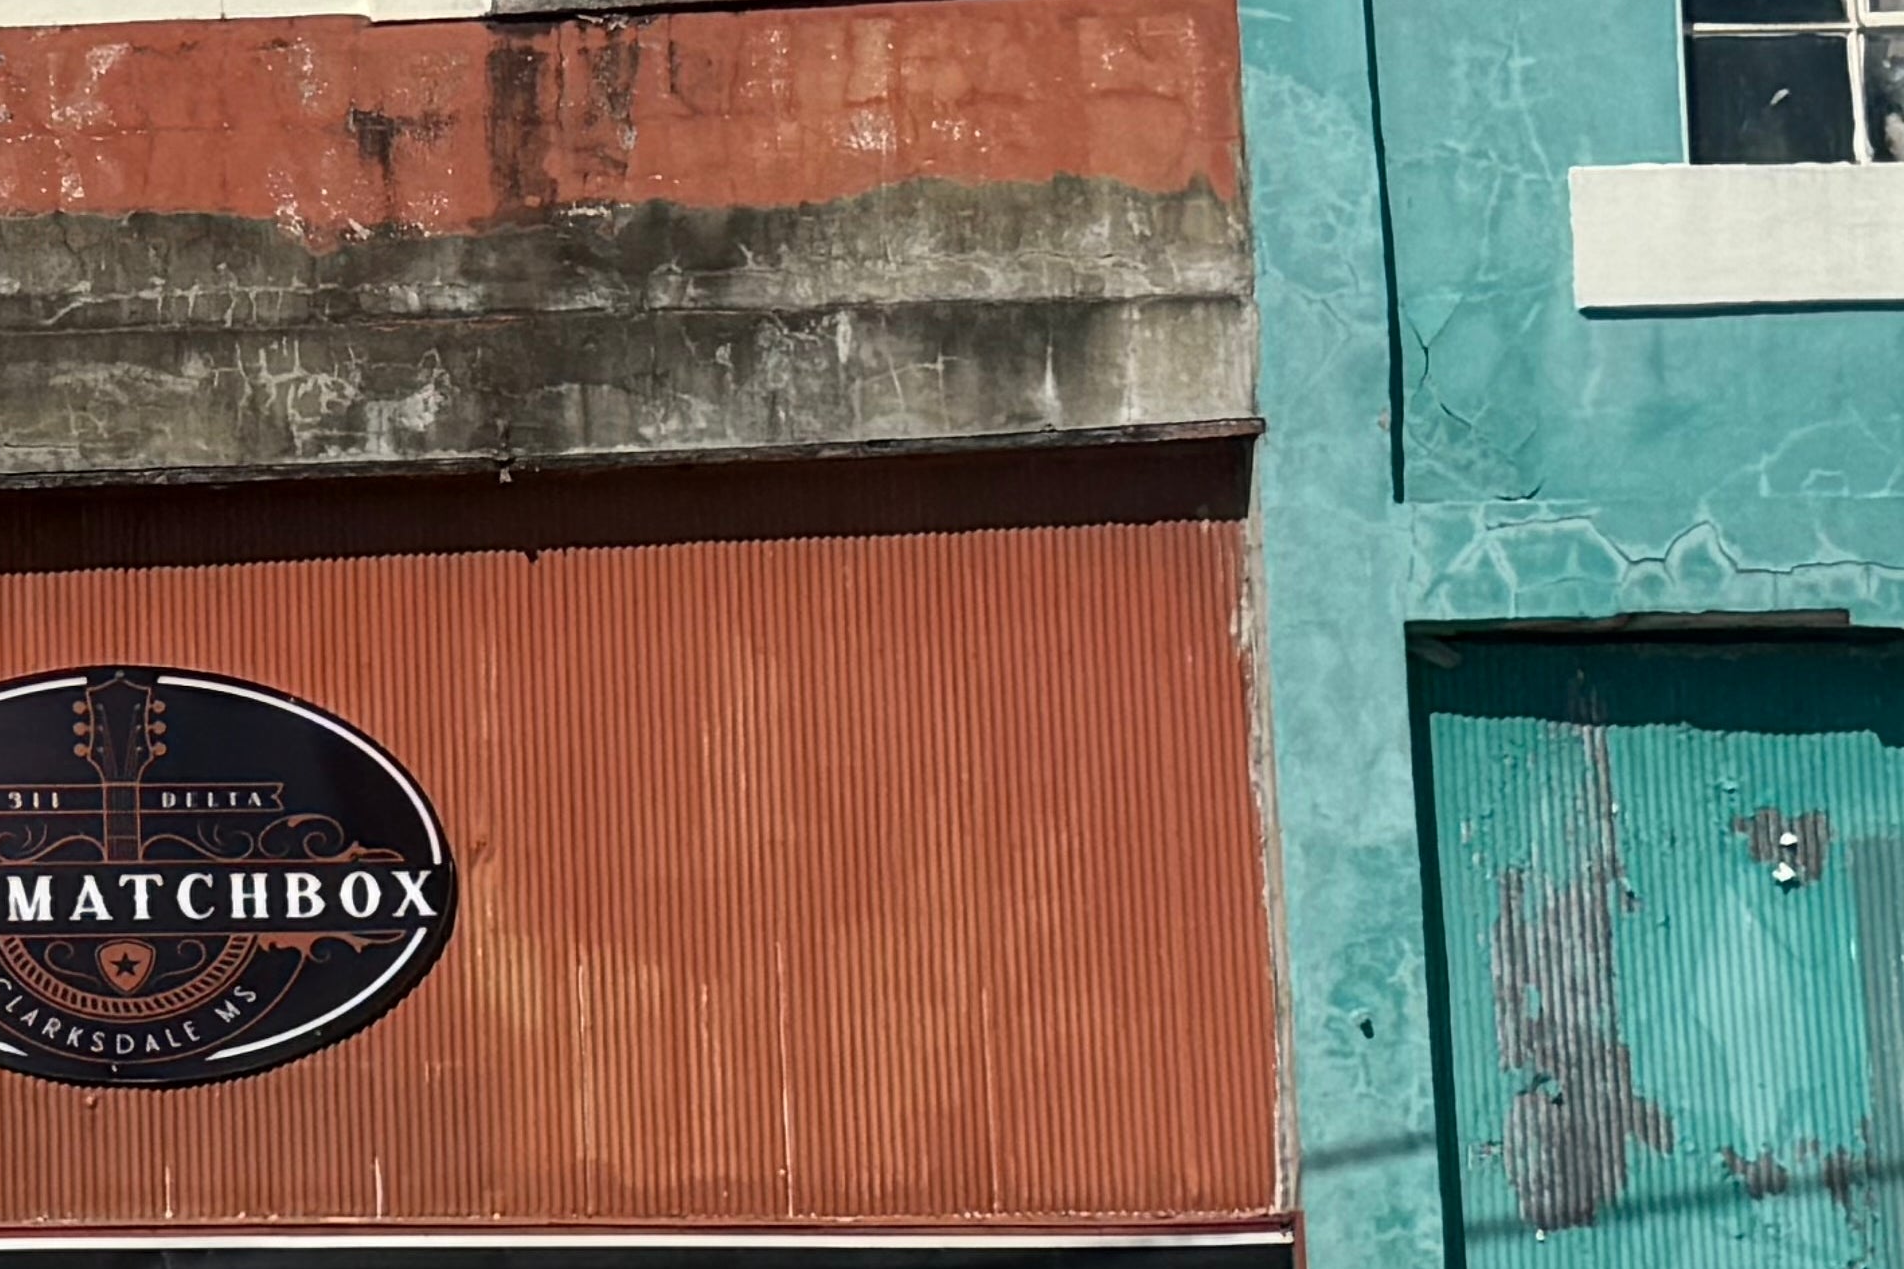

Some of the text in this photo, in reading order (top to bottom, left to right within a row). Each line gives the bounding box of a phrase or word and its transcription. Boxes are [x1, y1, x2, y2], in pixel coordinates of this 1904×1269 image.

[7, 790, 262, 809] 311 DELTA
[6, 870, 438, 923] MATCHBOX
[213, 984, 258, 1024] MS
